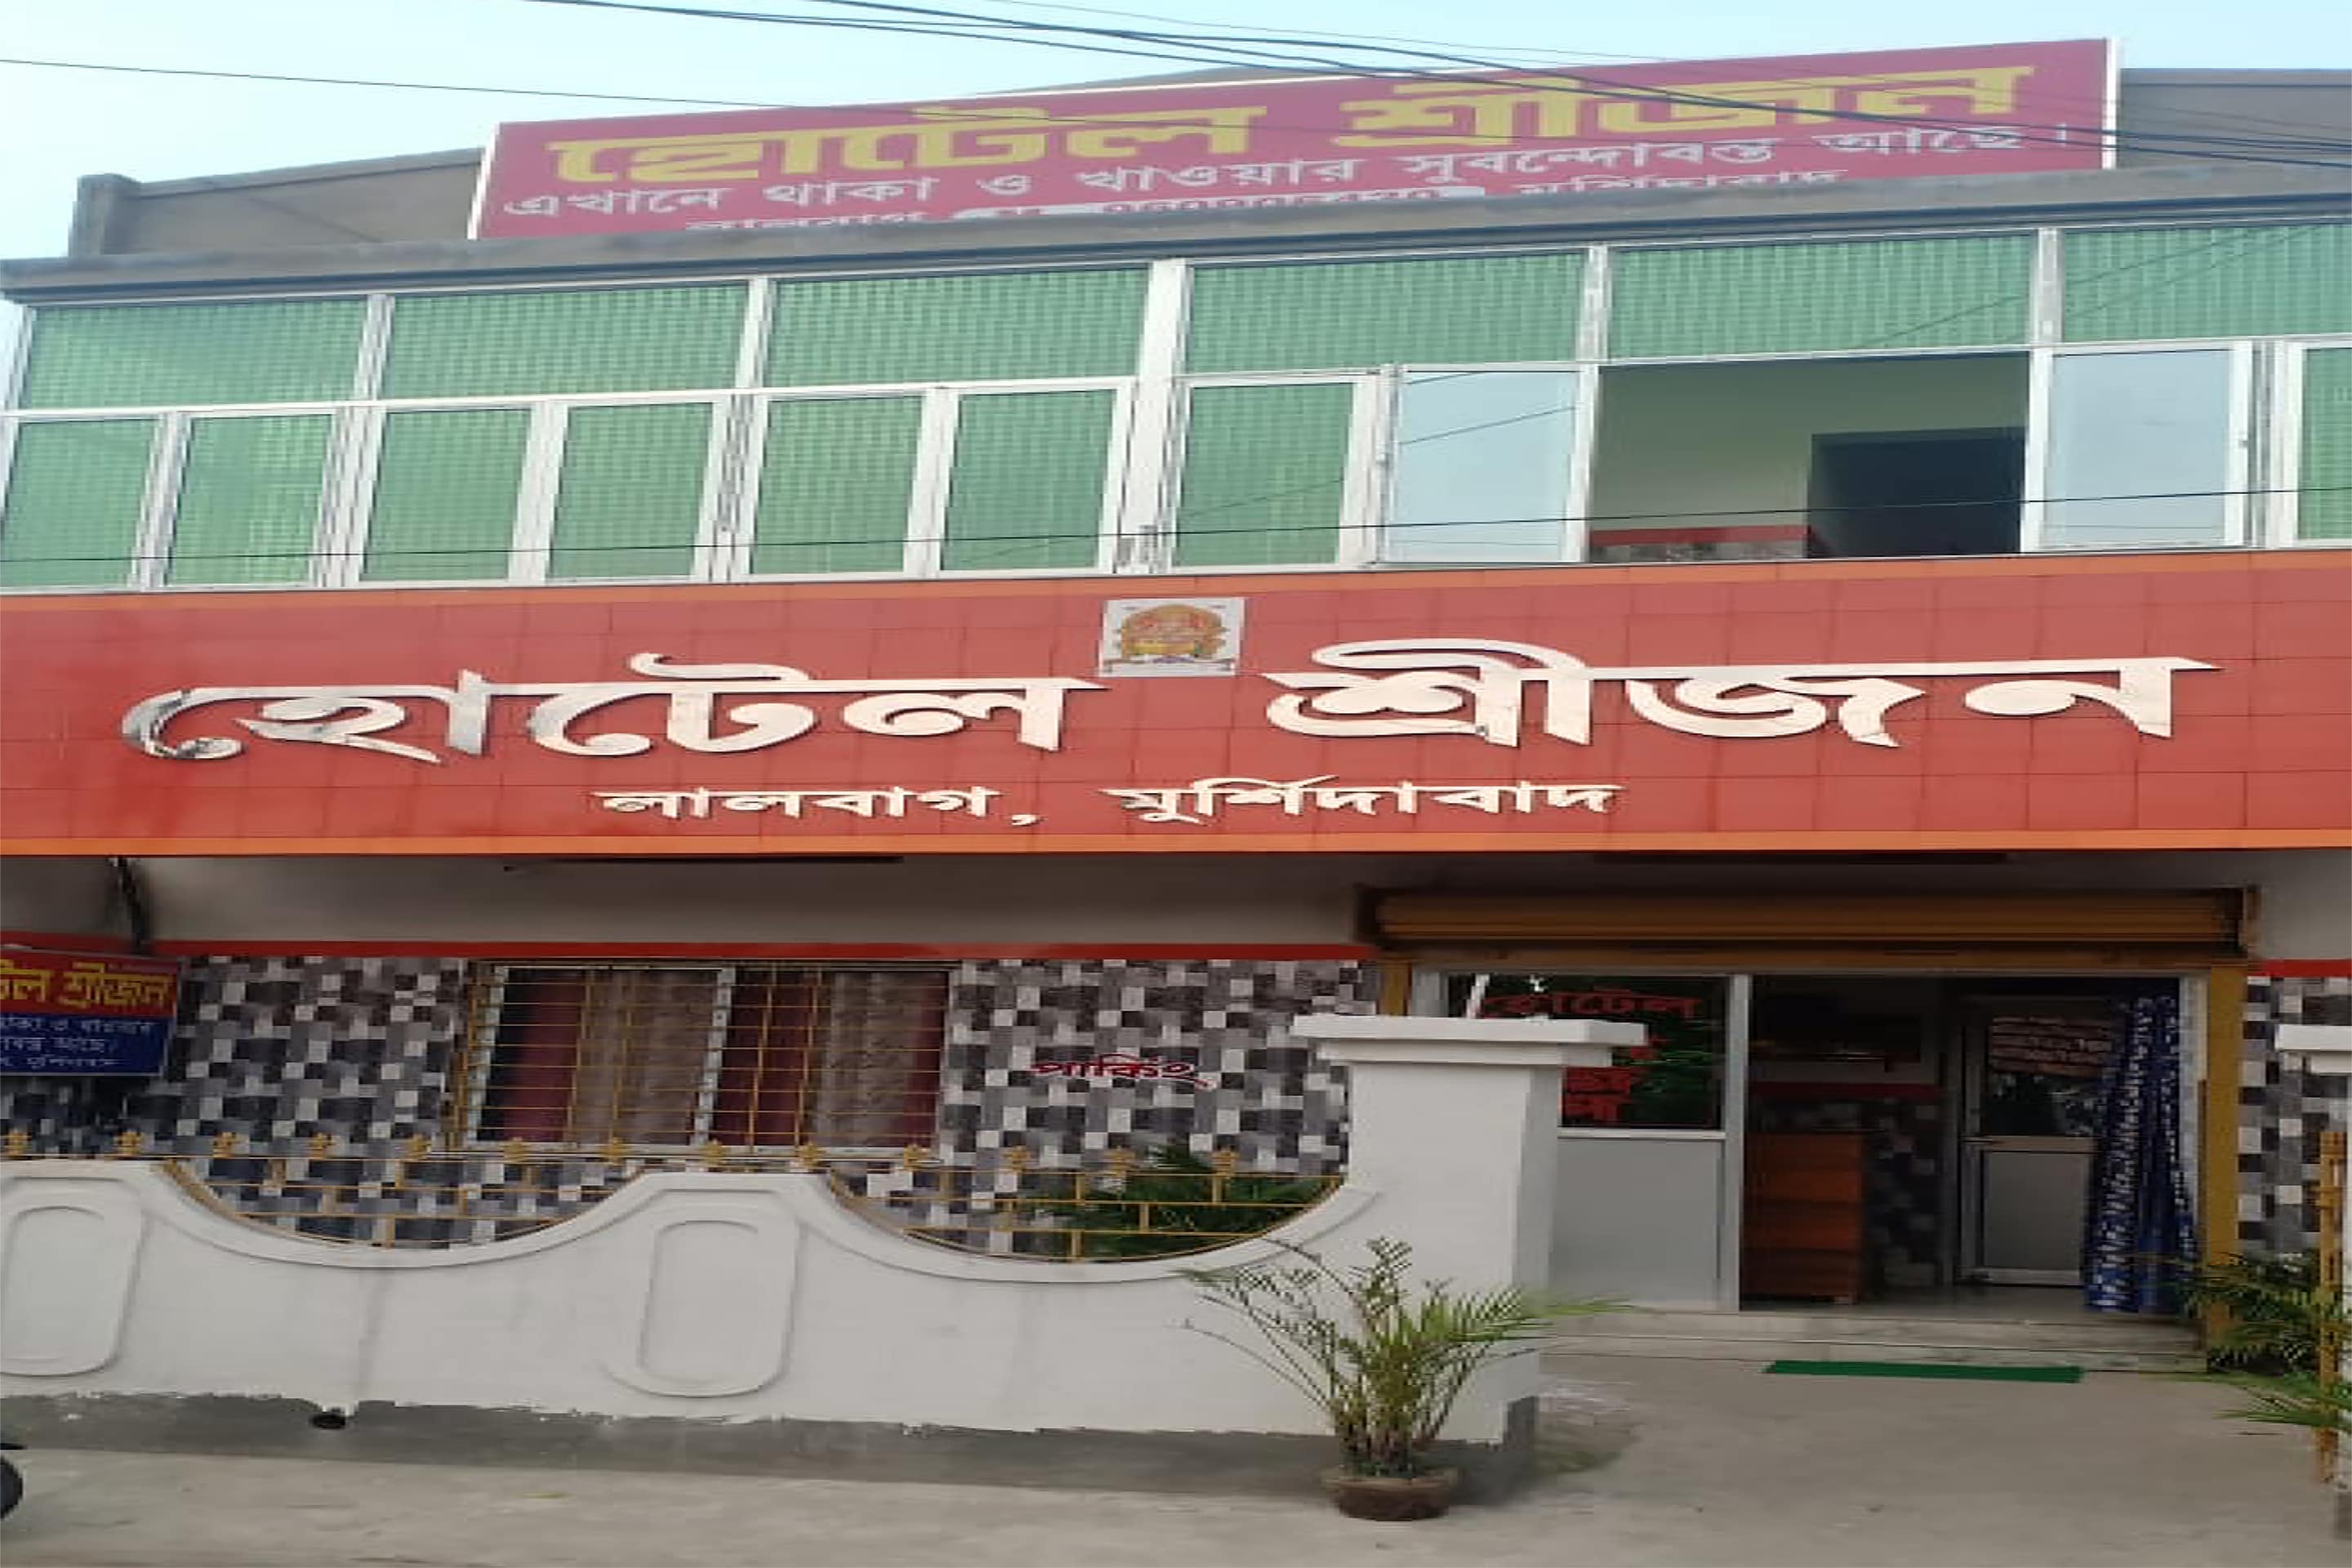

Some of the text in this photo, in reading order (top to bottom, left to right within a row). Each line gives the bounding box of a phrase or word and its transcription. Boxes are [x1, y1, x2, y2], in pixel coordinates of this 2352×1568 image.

[545, 65, 2034, 183] হোটেল শ্রীজন
[501, 186, 733, 216] এখানে
[763, 174, 939, 207] থাকা
[977, 173, 1032, 198] ও
[1075, 157, 1372, 194] খাওয়ার
[1390, 137, 1782, 185] সুবন্দোবস্ত
[122, 637, 2221, 764] হোটেল শ্রীজন
[592, 774, 1623, 826] লালবাগ, মুর্শিদাবাদ
